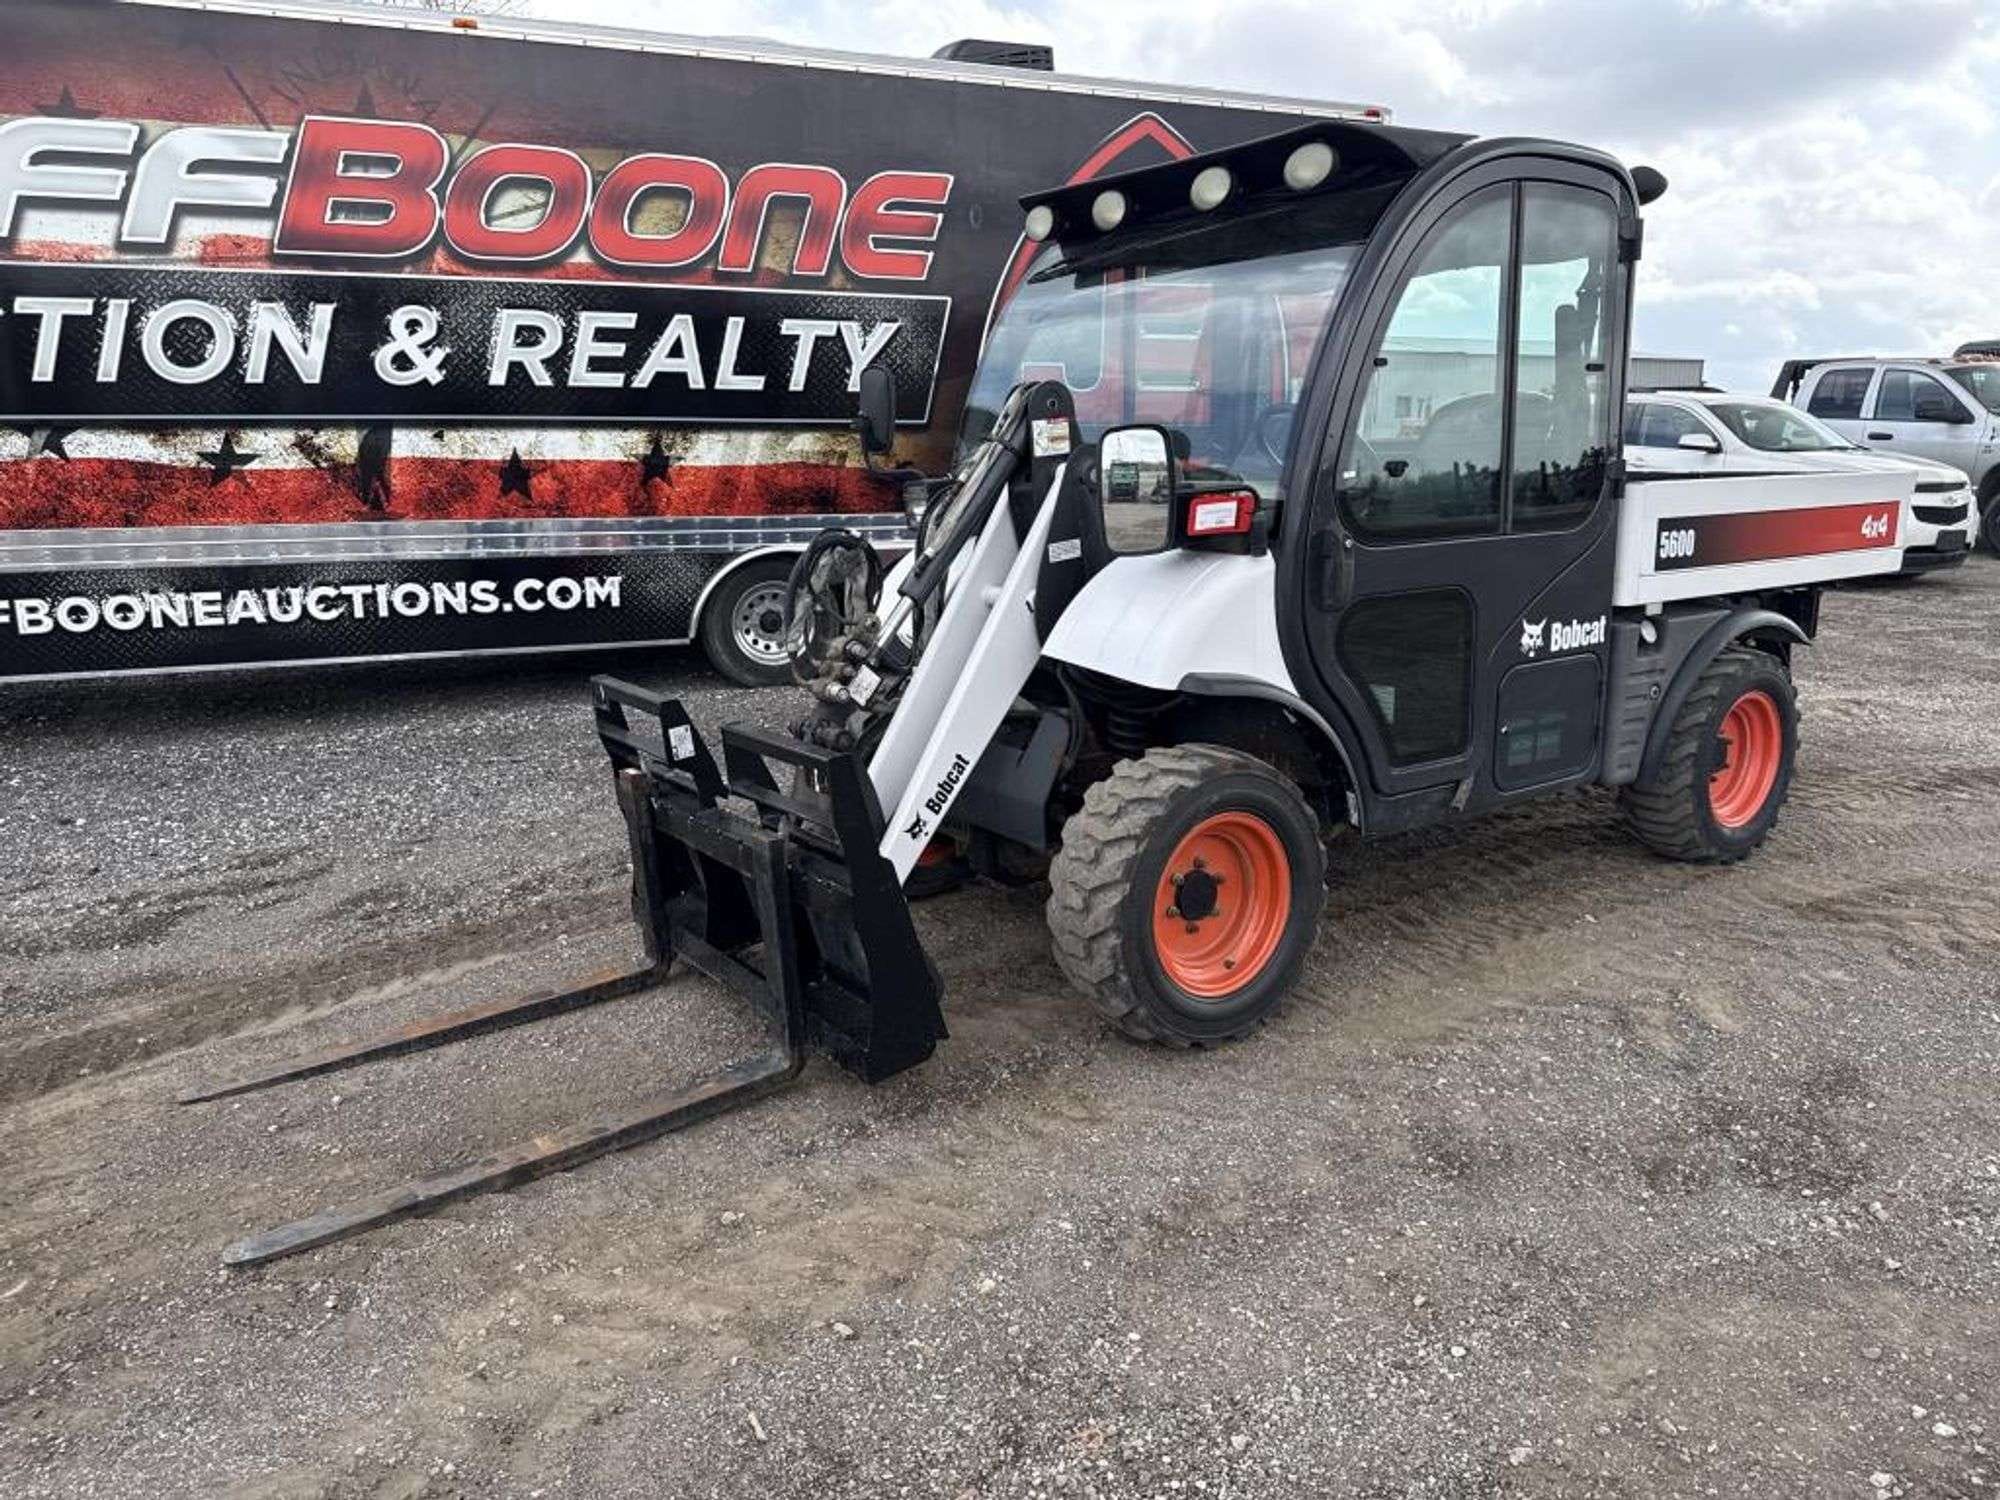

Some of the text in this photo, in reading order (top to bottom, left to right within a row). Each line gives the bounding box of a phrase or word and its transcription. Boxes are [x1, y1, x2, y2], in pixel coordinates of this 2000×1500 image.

[0, 296, 902, 392] TION & REALTY
[1659, 529, 1695, 558] 5600
[1861, 513, 1888, 539] 4x4
[1550, 615, 1607, 652] Bobcat
[925, 753, 970, 815] Bobcat
